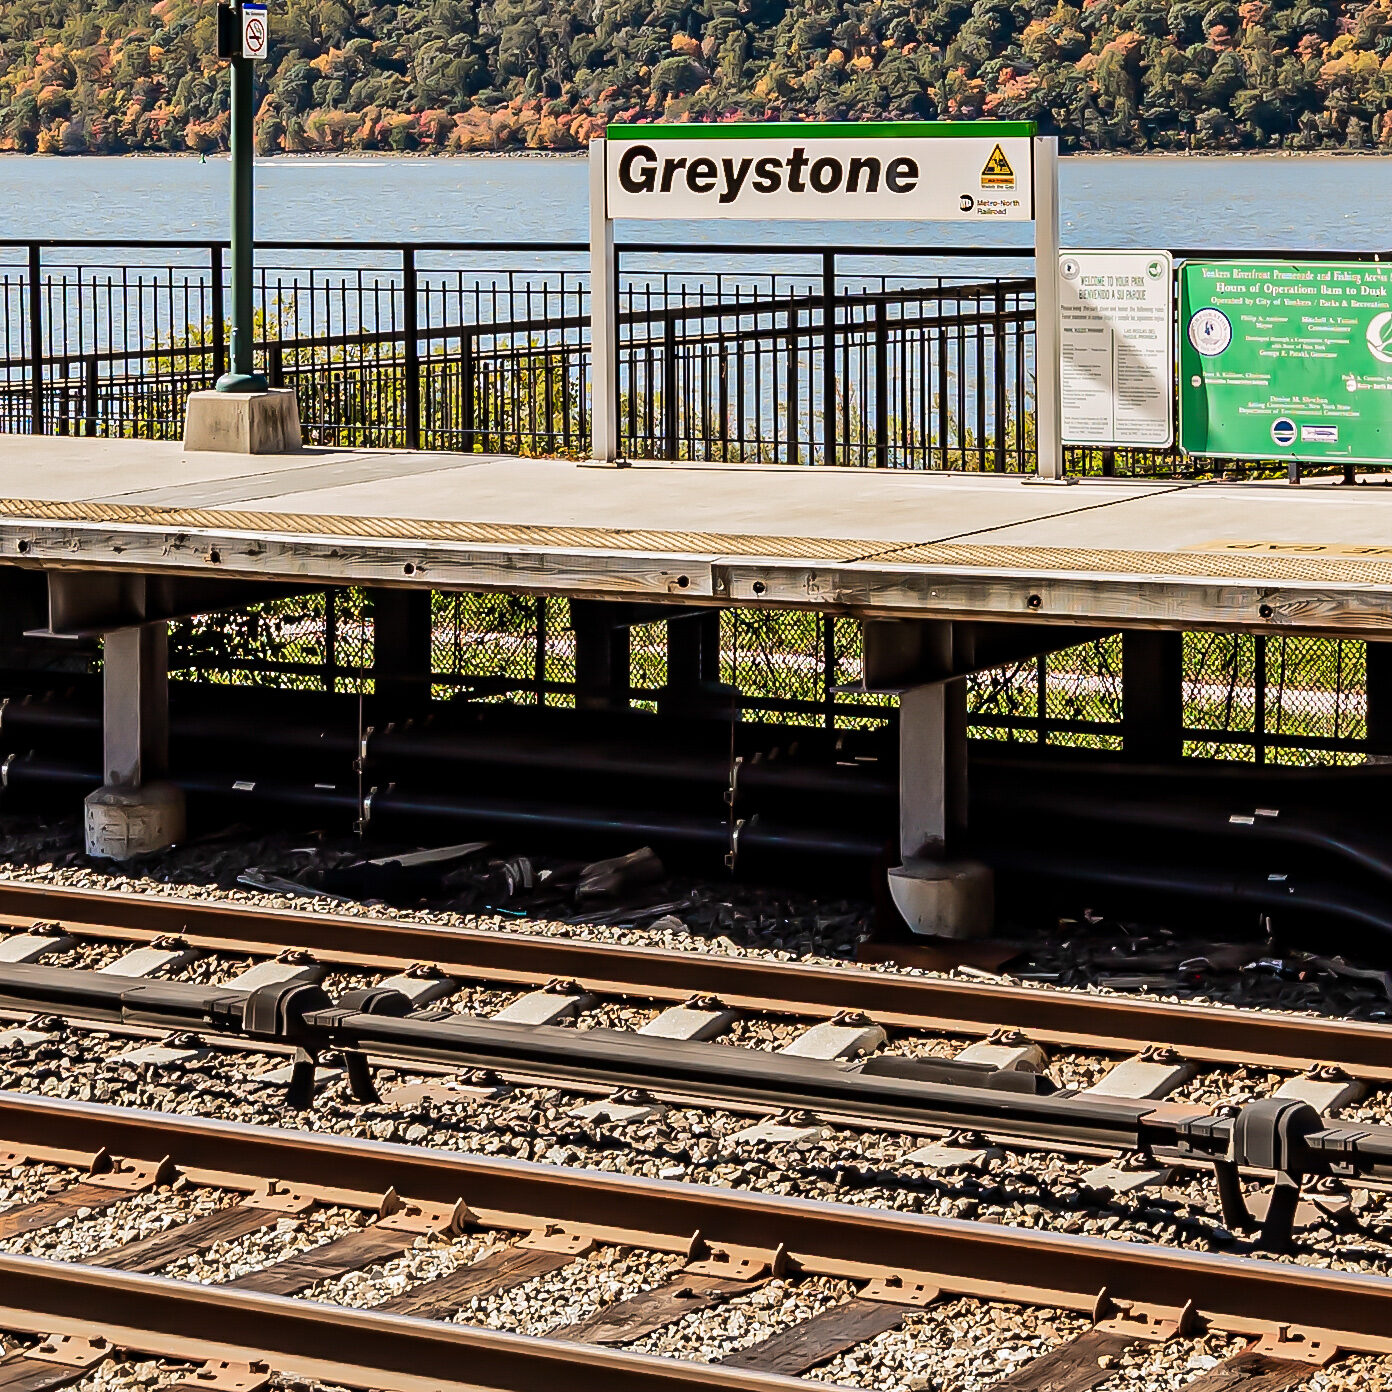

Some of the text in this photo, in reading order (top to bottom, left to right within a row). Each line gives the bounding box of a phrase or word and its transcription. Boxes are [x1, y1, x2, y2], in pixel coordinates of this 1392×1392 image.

[618, 145, 920, 204] Greystone
[1131, 276, 1145, 286] PARK
[1202, 268, 1231, 279] Yonkers
[1233, 268, 1270, 279] Riverfront
[1317, 271, 1331, 280] and
[1333, 271, 1361, 284] Fishing
[1216, 282, 1247, 292] Hours
[1249, 282, 1261, 292] of
[1346, 286, 1357, 295] to
[1360, 285, 1387, 296] Dusk
[1256, 298, 1271, 307] City
[1226, 543, 1327, 552] GAP
